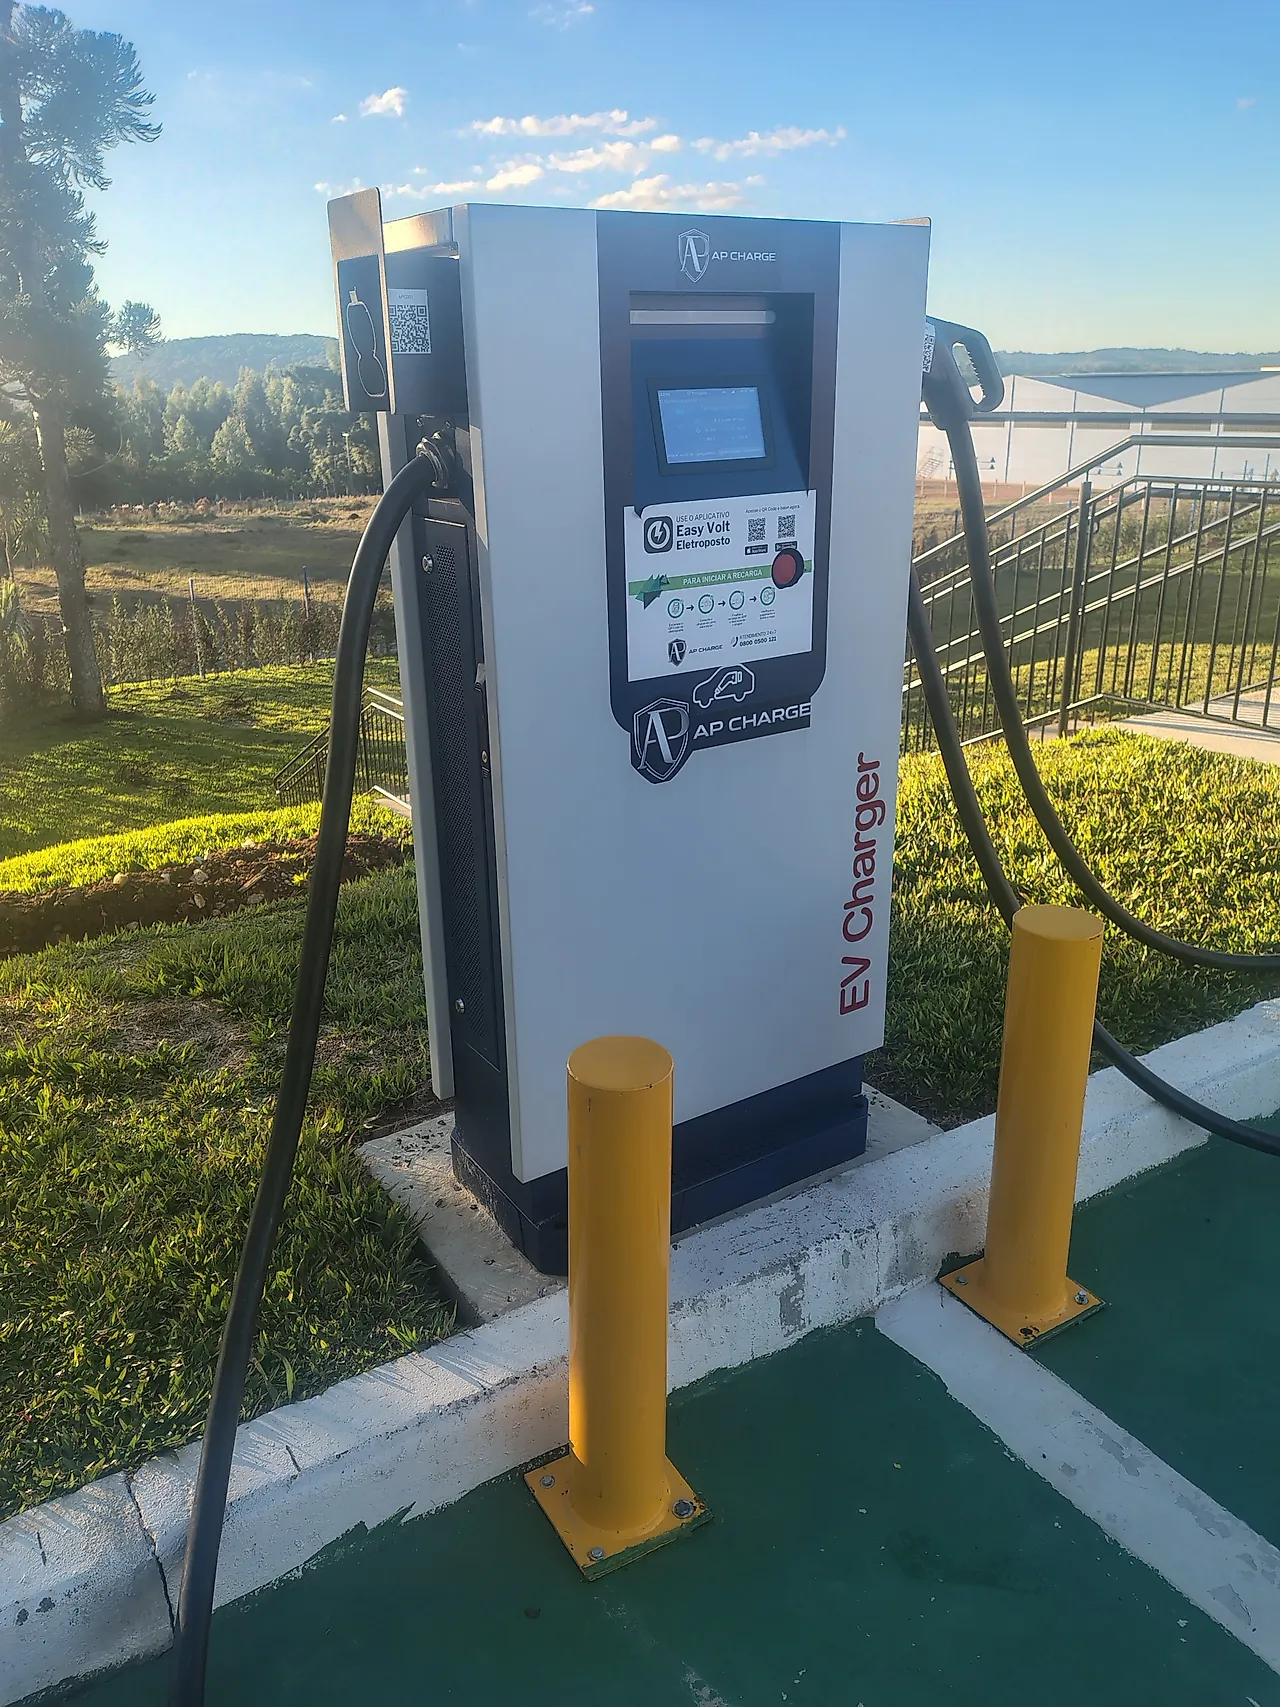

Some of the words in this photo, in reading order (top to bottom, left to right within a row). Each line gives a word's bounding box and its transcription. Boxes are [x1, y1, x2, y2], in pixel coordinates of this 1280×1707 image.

[711, 251, 728, 261] AP
[730, 251, 776, 262] CHARGE
[676, 515, 688, 523] USE
[695, 511, 730, 521] APLICATIVO
[676, 524, 704, 537] Easy
[707, 520, 731, 534] Volt
[676, 536, 731, 550] Eletroposto
[683, 577, 702, 586] PARA
[702, 574, 727, 584] INICIAR
[732, 569, 763, 579] RECARGA
[698, 644, 723, 653] CHARGE
[693, 720, 723, 740] AP
[728, 702, 812, 731] CHARGE
[842, 750, 887, 943] Charger
[839, 956, 872, 1016] EV
